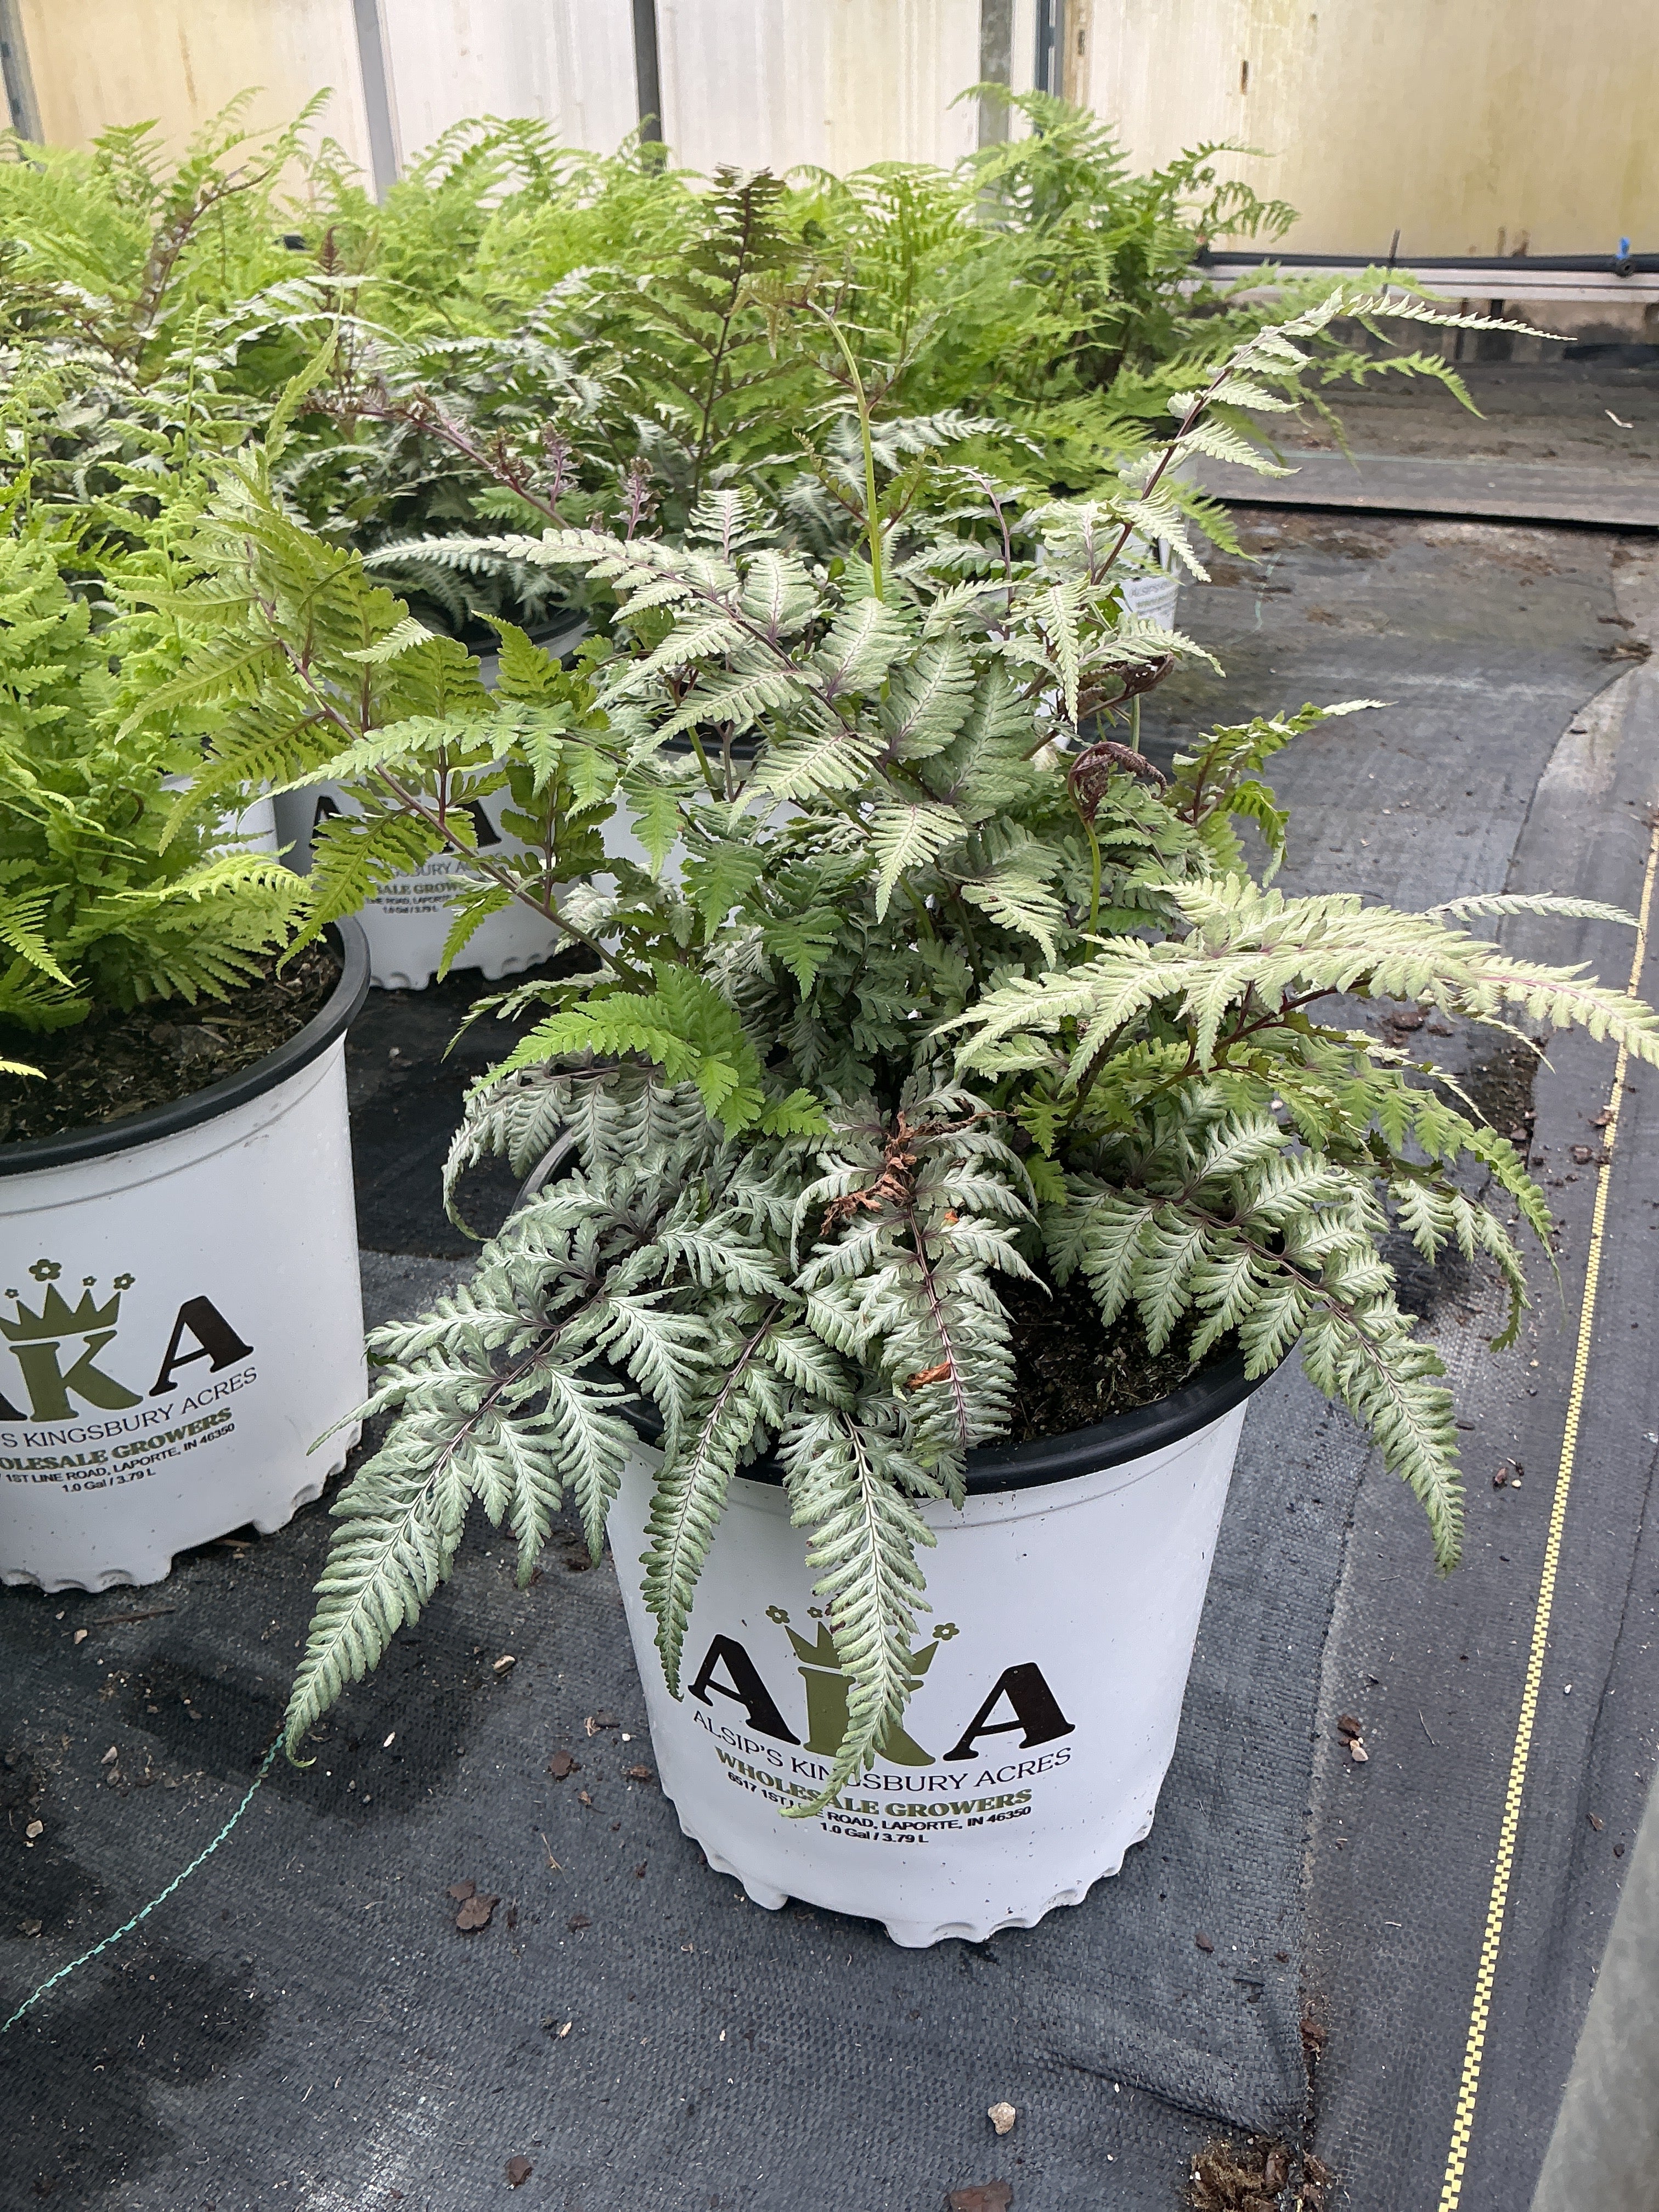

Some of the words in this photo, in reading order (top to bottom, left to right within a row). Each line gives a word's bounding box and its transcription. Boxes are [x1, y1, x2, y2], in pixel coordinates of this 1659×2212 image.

[0, 1296, 254, 1422] KA
[23, 1403, 173, 1447] KINGSBURY
[181, 1367, 257, 1415] ACRES
[111, 1407, 233, 1459] GROWERS
[5, 1474, 29, 1482] 1ST
[31, 1473, 63, 1483] LINE
[113, 1447, 181, 1472] LAPORTE,
[183, 1439, 198, 1451] IN
[200, 1423, 235, 1443] 46350
[61, 1483, 82, 1492] 1.0
[84, 1479, 106, 1490] Gal
[117, 1471, 144, 1484] 3.79
[146, 1468, 156, 1476] L
[693, 1710, 783, 1767] ALSIP'S
[973, 1747, 1071, 1787] ACRES
[728, 1771, 757, 1792] 6517
[761, 1789, 787, 1805] 1ST
[882, 1819, 963, 1830] LAPORTE,
[967, 1816, 984, 1827] IN
[986, 1806, 1031, 1822] 46350
[885, 1788, 1032, 1817] GROWERS
[820, 1822, 842, 1834] 1.0
[844, 1827, 870, 1840] Gal
[873, 1832, 879, 1841] /
[882, 1833, 915, 1843] 3.79
[918, 1834, 929, 1843] L
